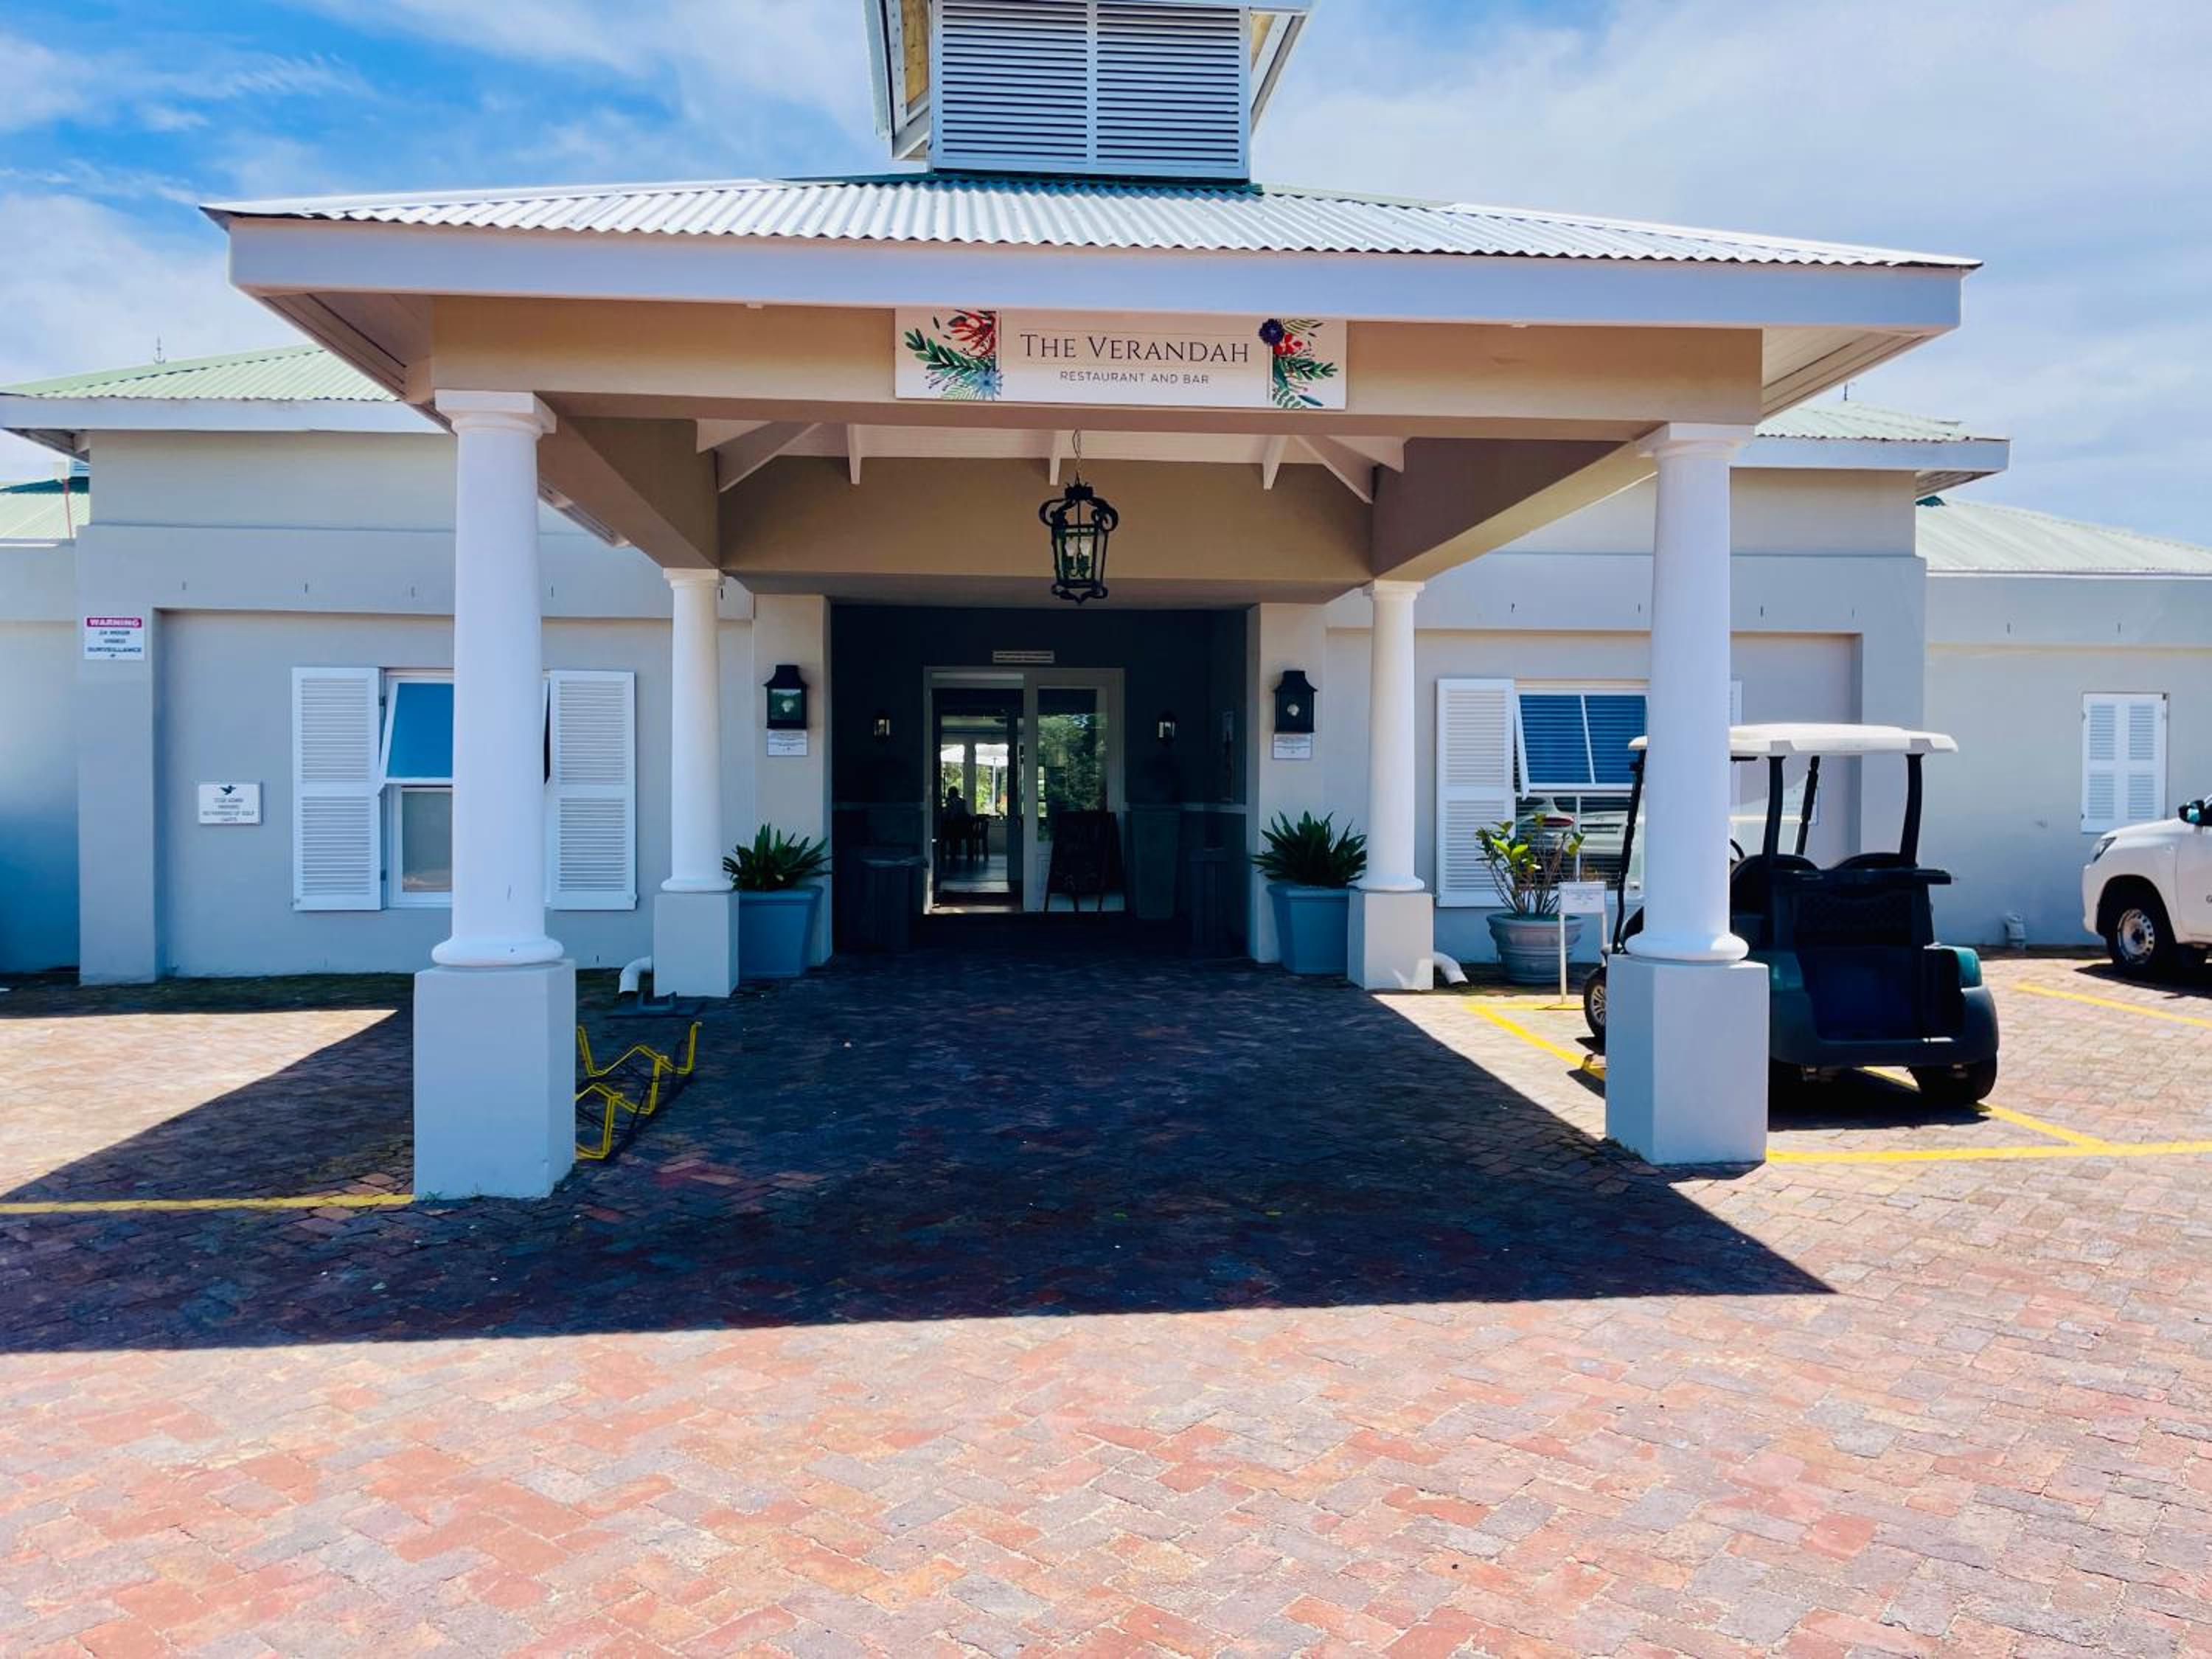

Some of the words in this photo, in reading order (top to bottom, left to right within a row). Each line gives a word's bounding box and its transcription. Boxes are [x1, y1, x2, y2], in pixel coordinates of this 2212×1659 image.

[1020, 334, 1076, 358] THE
[1088, 336, 1249, 363] VERANDAH
[1060, 371, 1144, 383] RESTAURANT
[1150, 374, 1178, 384] AND
[1184, 375, 1208, 384] BAR
[89, 619, 140, 627] WARNING
